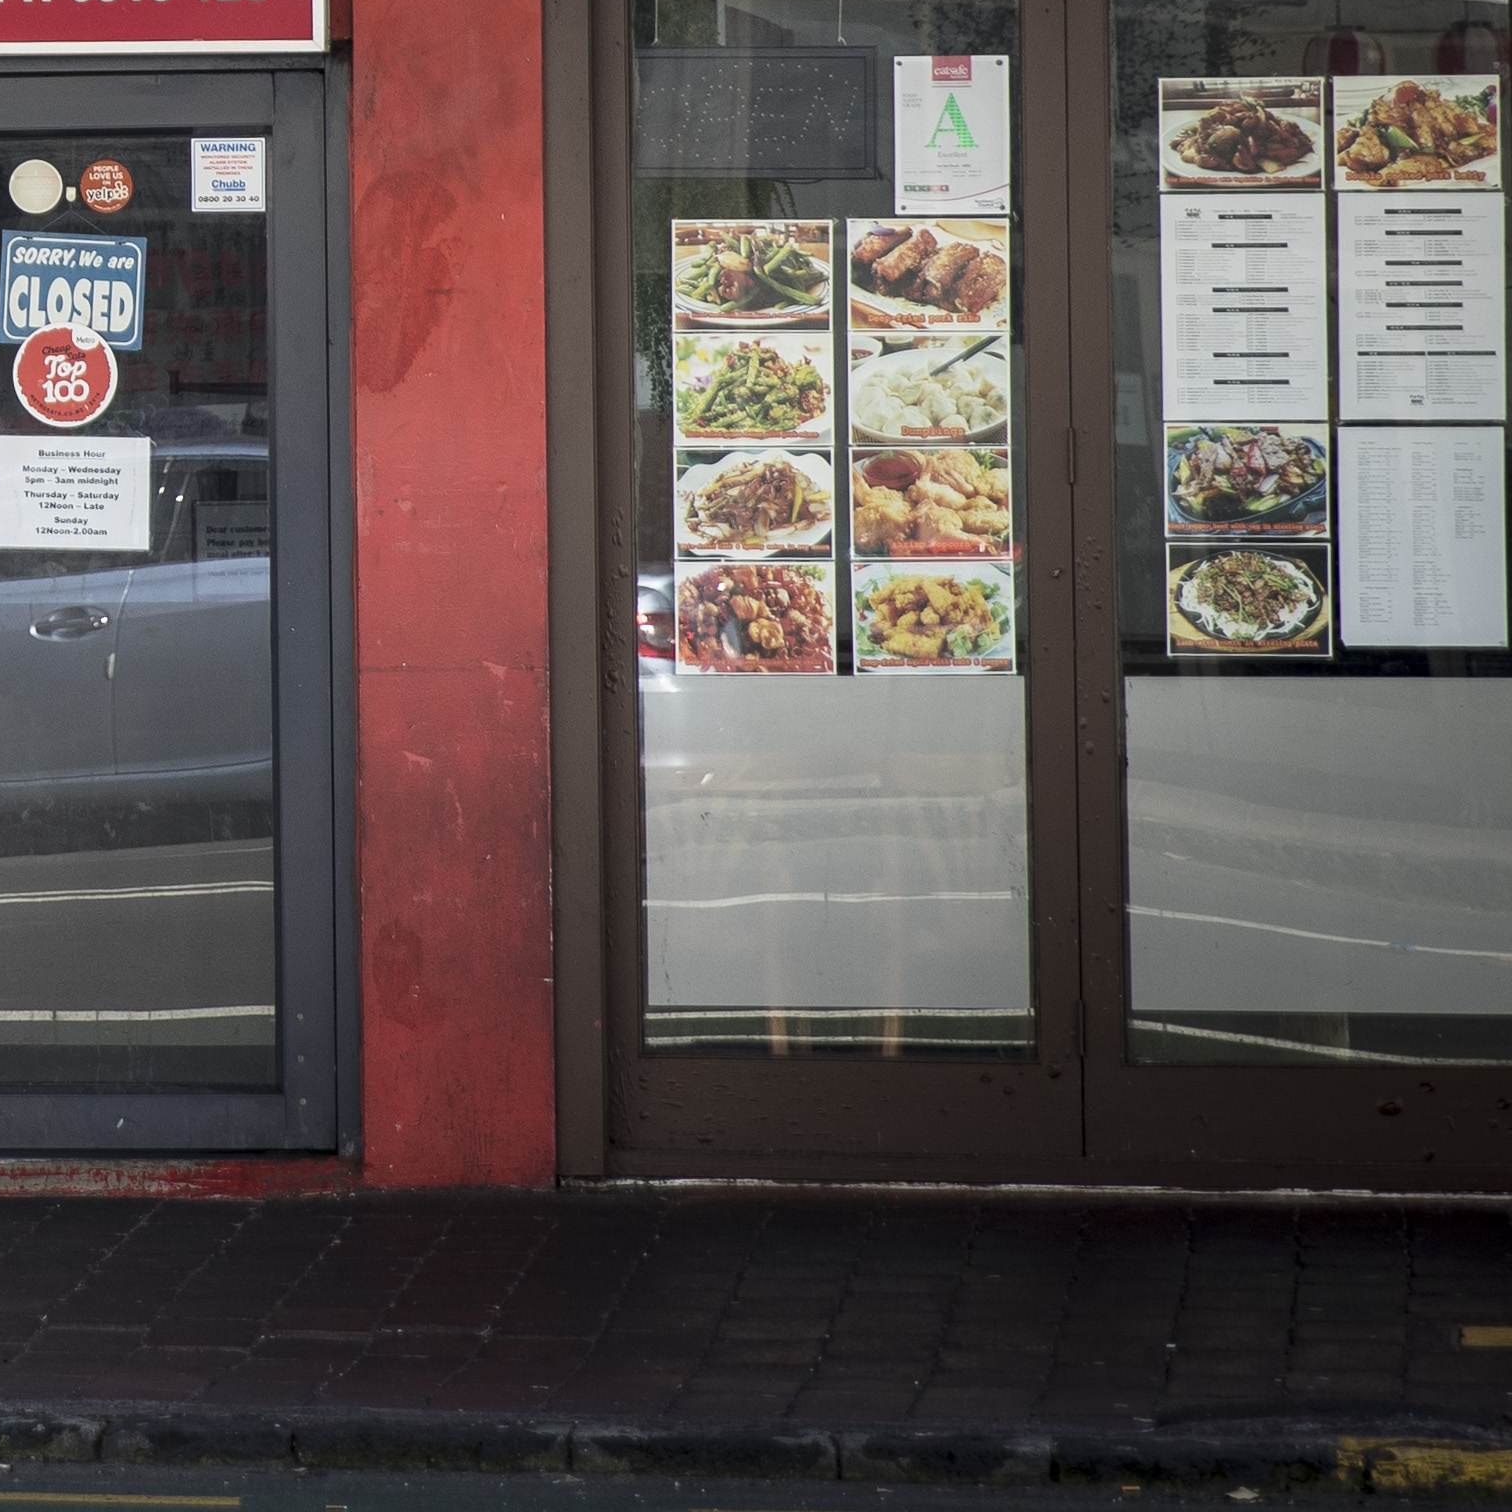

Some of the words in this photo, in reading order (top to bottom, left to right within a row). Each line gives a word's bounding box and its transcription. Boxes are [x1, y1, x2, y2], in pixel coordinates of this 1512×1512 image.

[933, 64, 969, 76] eatsafe
[924, 92, 980, 148] A
[200, 143, 256, 153] WARNING
[89, 172, 111, 180] LOVE
[211, 179, 246, 189] Chubb
[86, 186, 116, 203] yelp
[198, 195, 220, 203] 0800
[222, 195, 233, 203] 20
[236, 195, 247, 203] 30
[248, 195, 260, 203] 40
[12, 246, 77, 268] SORRY,
[78, 250, 104, 267] We
[107, 255, 135, 269] are
[9, 274, 134, 333] CLOSED
[867, 314, 926, 324] Deep-fried
[928, 314, 953, 323] pork
[956, 313, 981, 323] ribs
[76, 335, 96, 344] Metro
[41, 344, 71, 357] Cheap
[44, 354, 87, 382] Top
[41, 379, 90, 404] 100
[900, 426, 966, 438] Dumplings
[38, 449, 81, 458] Business
[83, 450, 106, 458] Hour
[22, 465, 58, 475] Monday
[68, 466, 122, 476] Wednesday
[24, 476, 45, 485] 5pm
[54, 476, 75, 485] 3am
[77, 476, 119, 486] midnight
[24, 490, 67, 500] Thursday
[77, 491, 120, 501] Saturday
[38, 502, 74, 510] 12Noon
[83, 502, 105, 510] Late
[54, 516, 89, 525] Sunday
